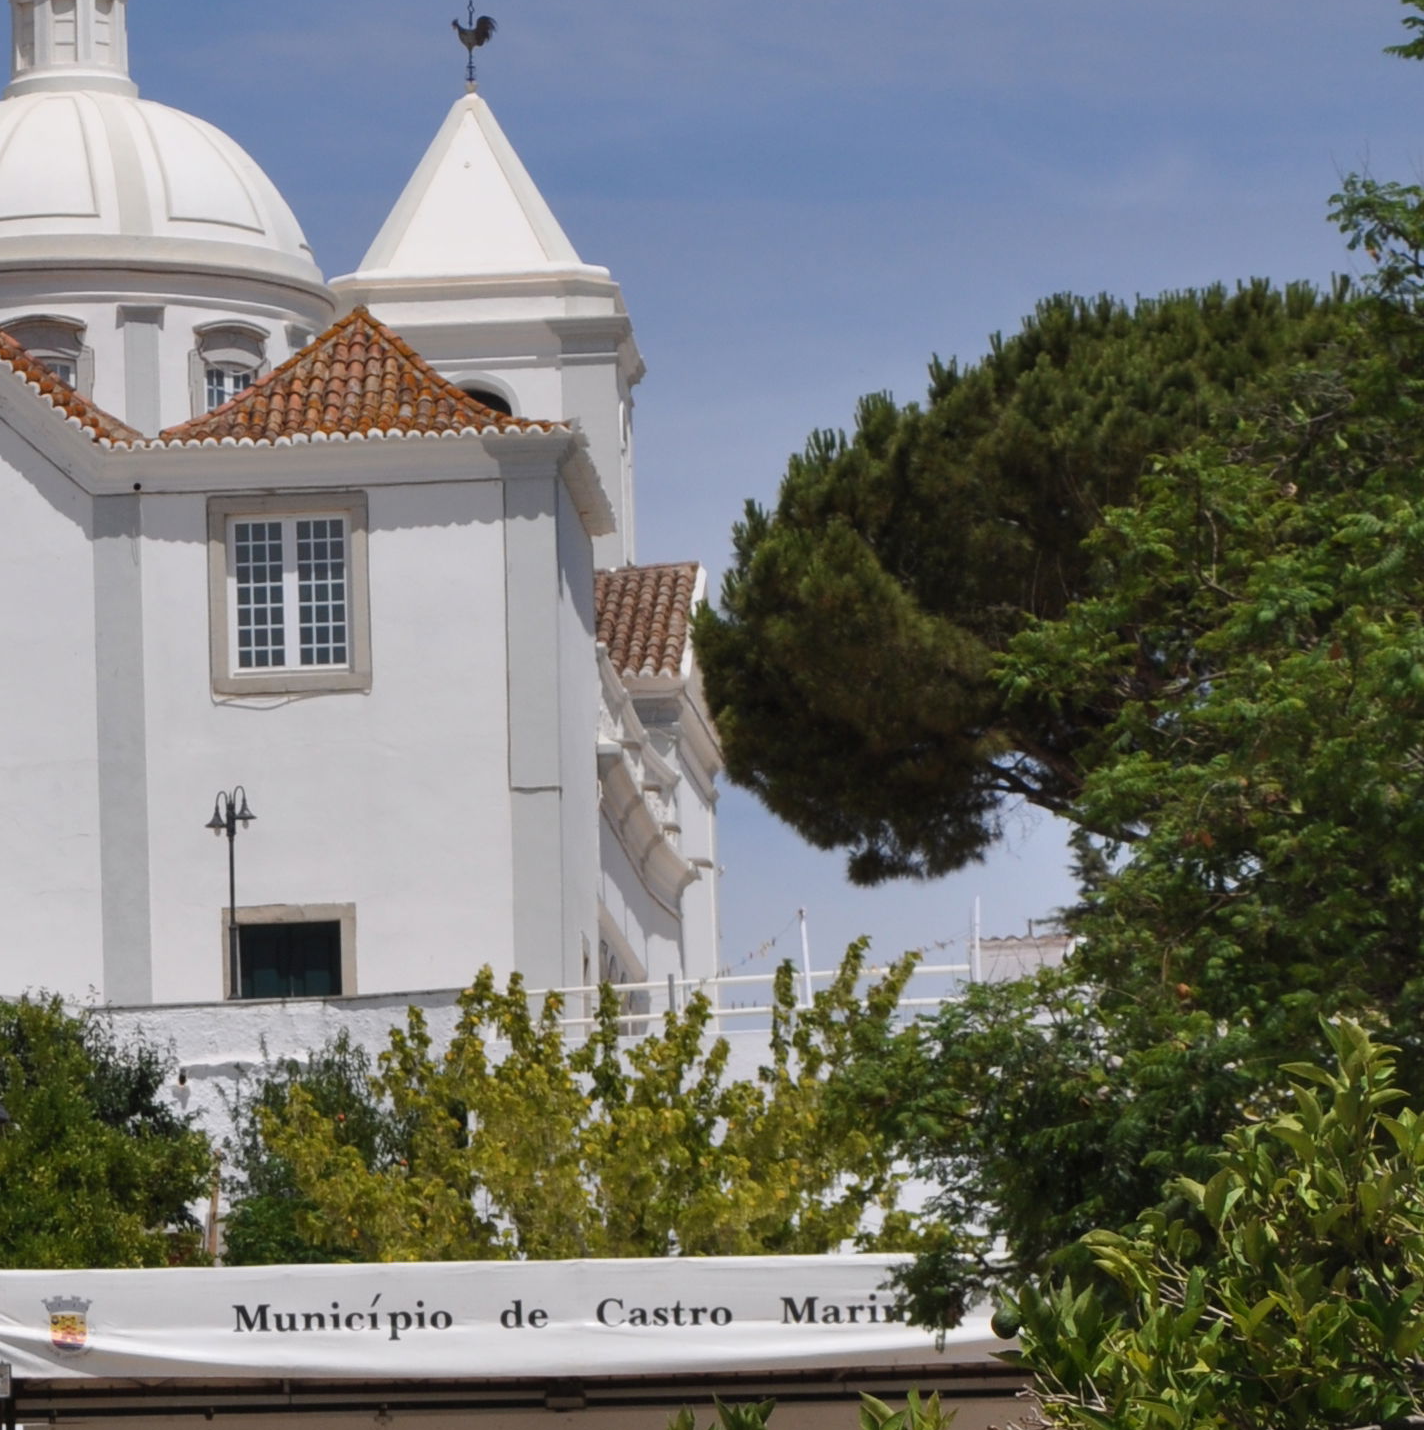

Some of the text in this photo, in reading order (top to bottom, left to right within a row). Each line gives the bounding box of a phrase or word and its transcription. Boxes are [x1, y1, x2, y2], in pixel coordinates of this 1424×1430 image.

[232, 1293, 453, 1341] Município
[500, 1299, 549, 1329] de
[596, 1297, 733, 1327] Castro
